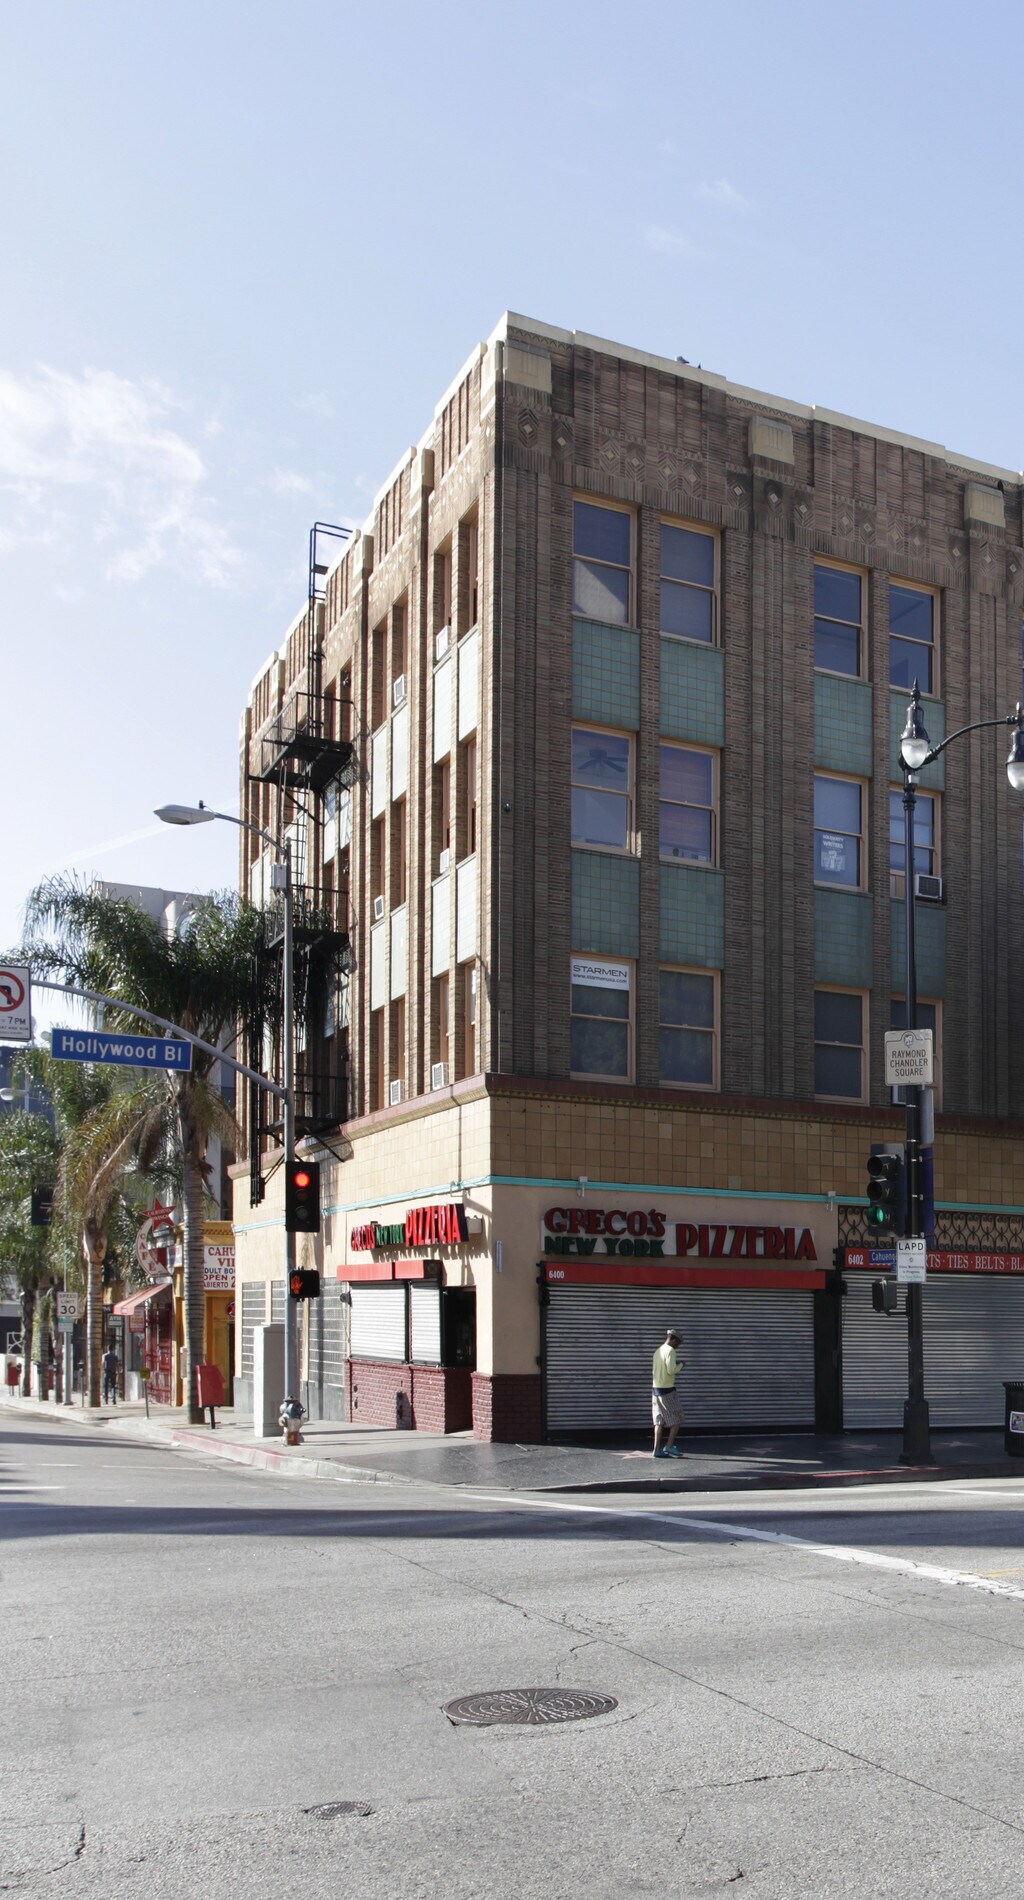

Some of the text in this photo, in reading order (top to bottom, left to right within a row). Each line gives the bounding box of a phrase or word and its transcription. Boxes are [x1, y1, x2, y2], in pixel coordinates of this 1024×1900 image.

[573, 964, 627, 978] STARMEN
[7, 1015, 13, 1024] 7
[15, 1017, 26, 1025] PM
[62, 1036, 182, 1062] Hollywood Bl
[891, 1049, 926, 1058] RAYMOND
[890, 1058, 929, 1068] CHANDLER
[895, 1067, 924, 1077] SQUARE
[405, 1203, 462, 1247] PIZZERIA
[544, 1207, 667, 1237] GRECO'S
[544, 1236, 666, 1258] NEW YORK
[676, 1223, 818, 1260] PIZZERIA
[898, 1242, 924, 1251] LAPD
[848, 1254, 864, 1265] 6402
[947, 1255, 969, 1268] TIES
[975, 1255, 1005, 1270] BELTS
[548, 1270, 565, 1279] 6400
[60, 1305, 76, 1315] 30
